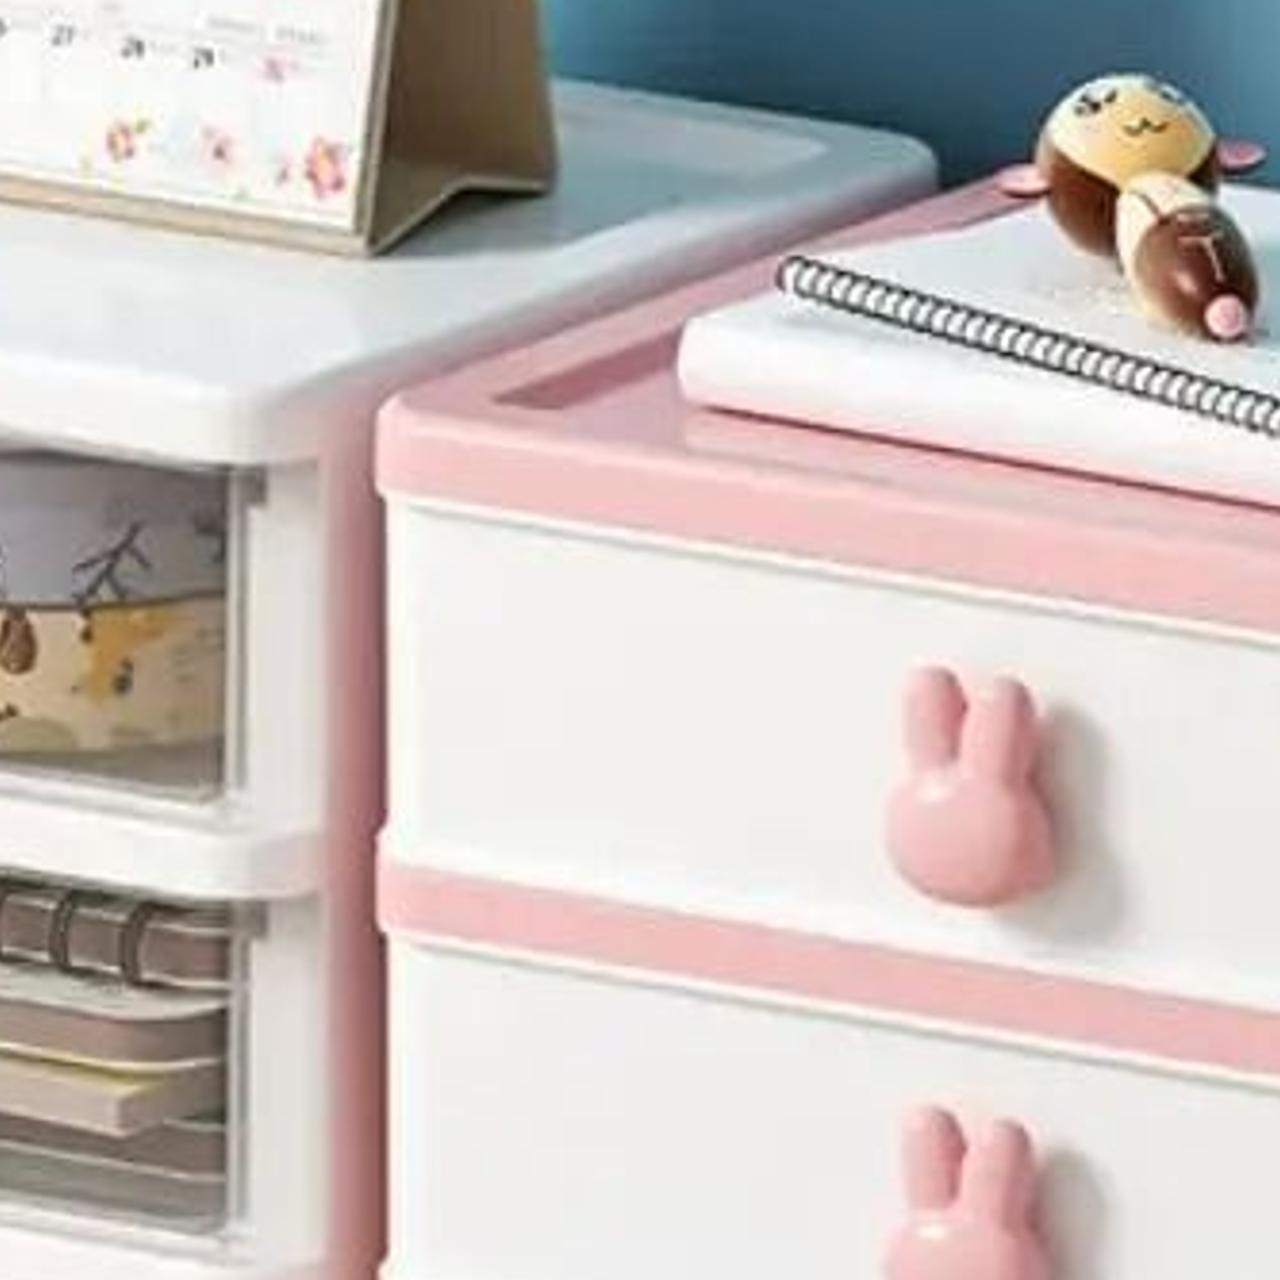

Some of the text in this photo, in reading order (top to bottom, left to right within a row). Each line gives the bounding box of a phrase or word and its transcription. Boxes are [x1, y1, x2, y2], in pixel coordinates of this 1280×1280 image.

[51, 25, 76, 46] 27
[121, 37, 145, 58] 28
[193, 48, 214, 69] 29
